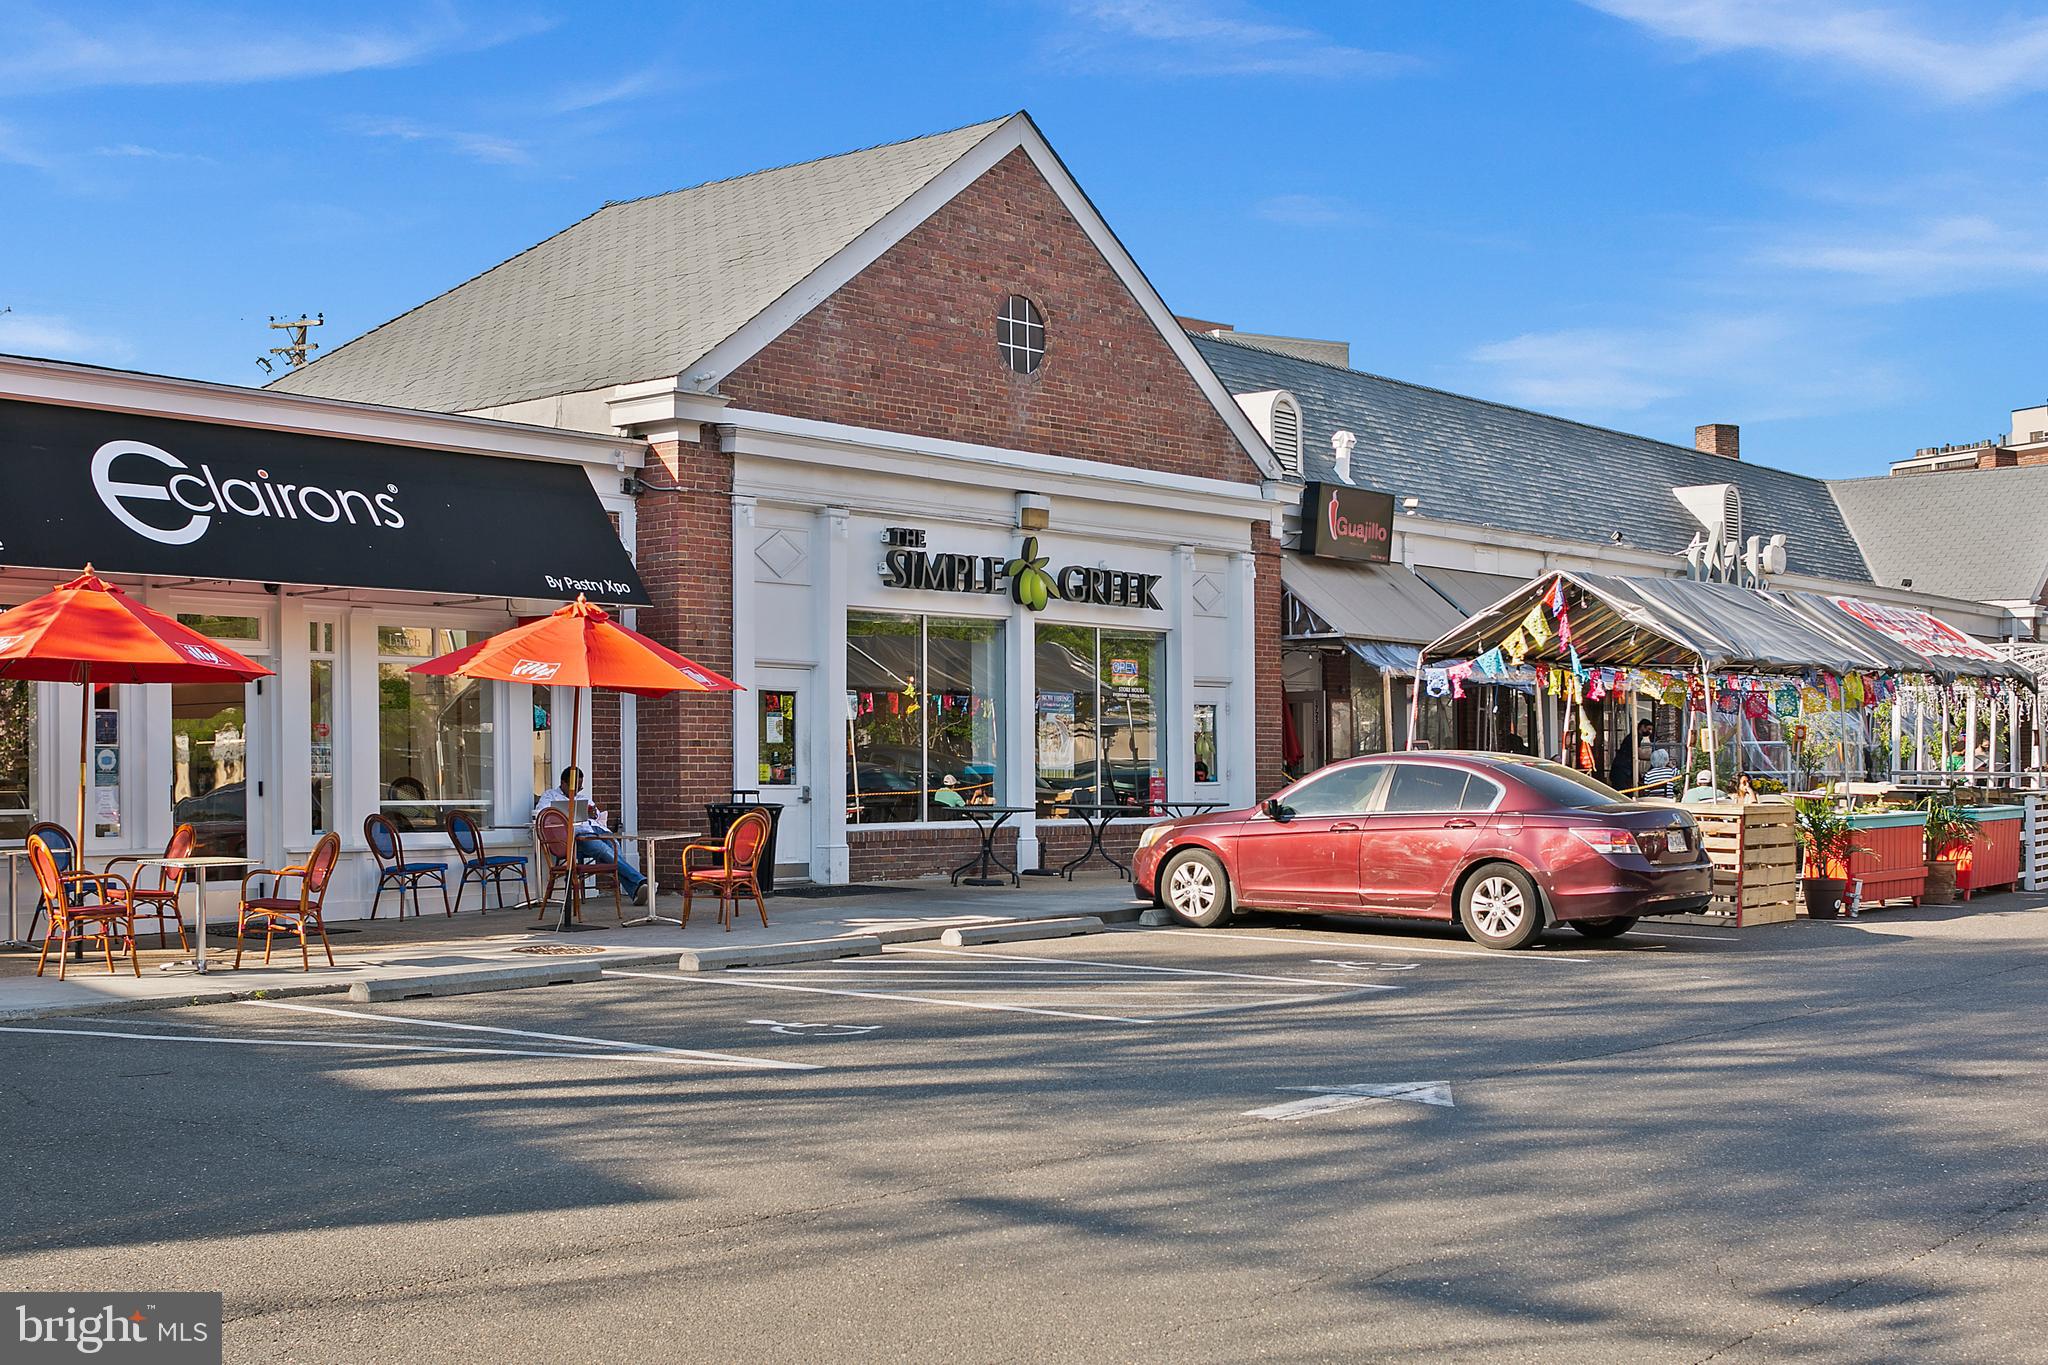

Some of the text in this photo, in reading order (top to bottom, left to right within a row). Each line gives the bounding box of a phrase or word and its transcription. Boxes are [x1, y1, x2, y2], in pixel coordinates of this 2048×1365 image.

[91, 440, 405, 545] Eclairons
[887, 527, 927, 548] THE
[1336, 516, 1387, 544] Guajillo
[544, 575, 631, 596] By Pastry Xpo
[883, 549, 1164, 611] SIMPLE GREEK
[388, 633, 421, 648] Lunch
[183, 644, 220, 665] illy
[513, 662, 556, 680] illy
[1112, 661, 1138, 674] OPEN
